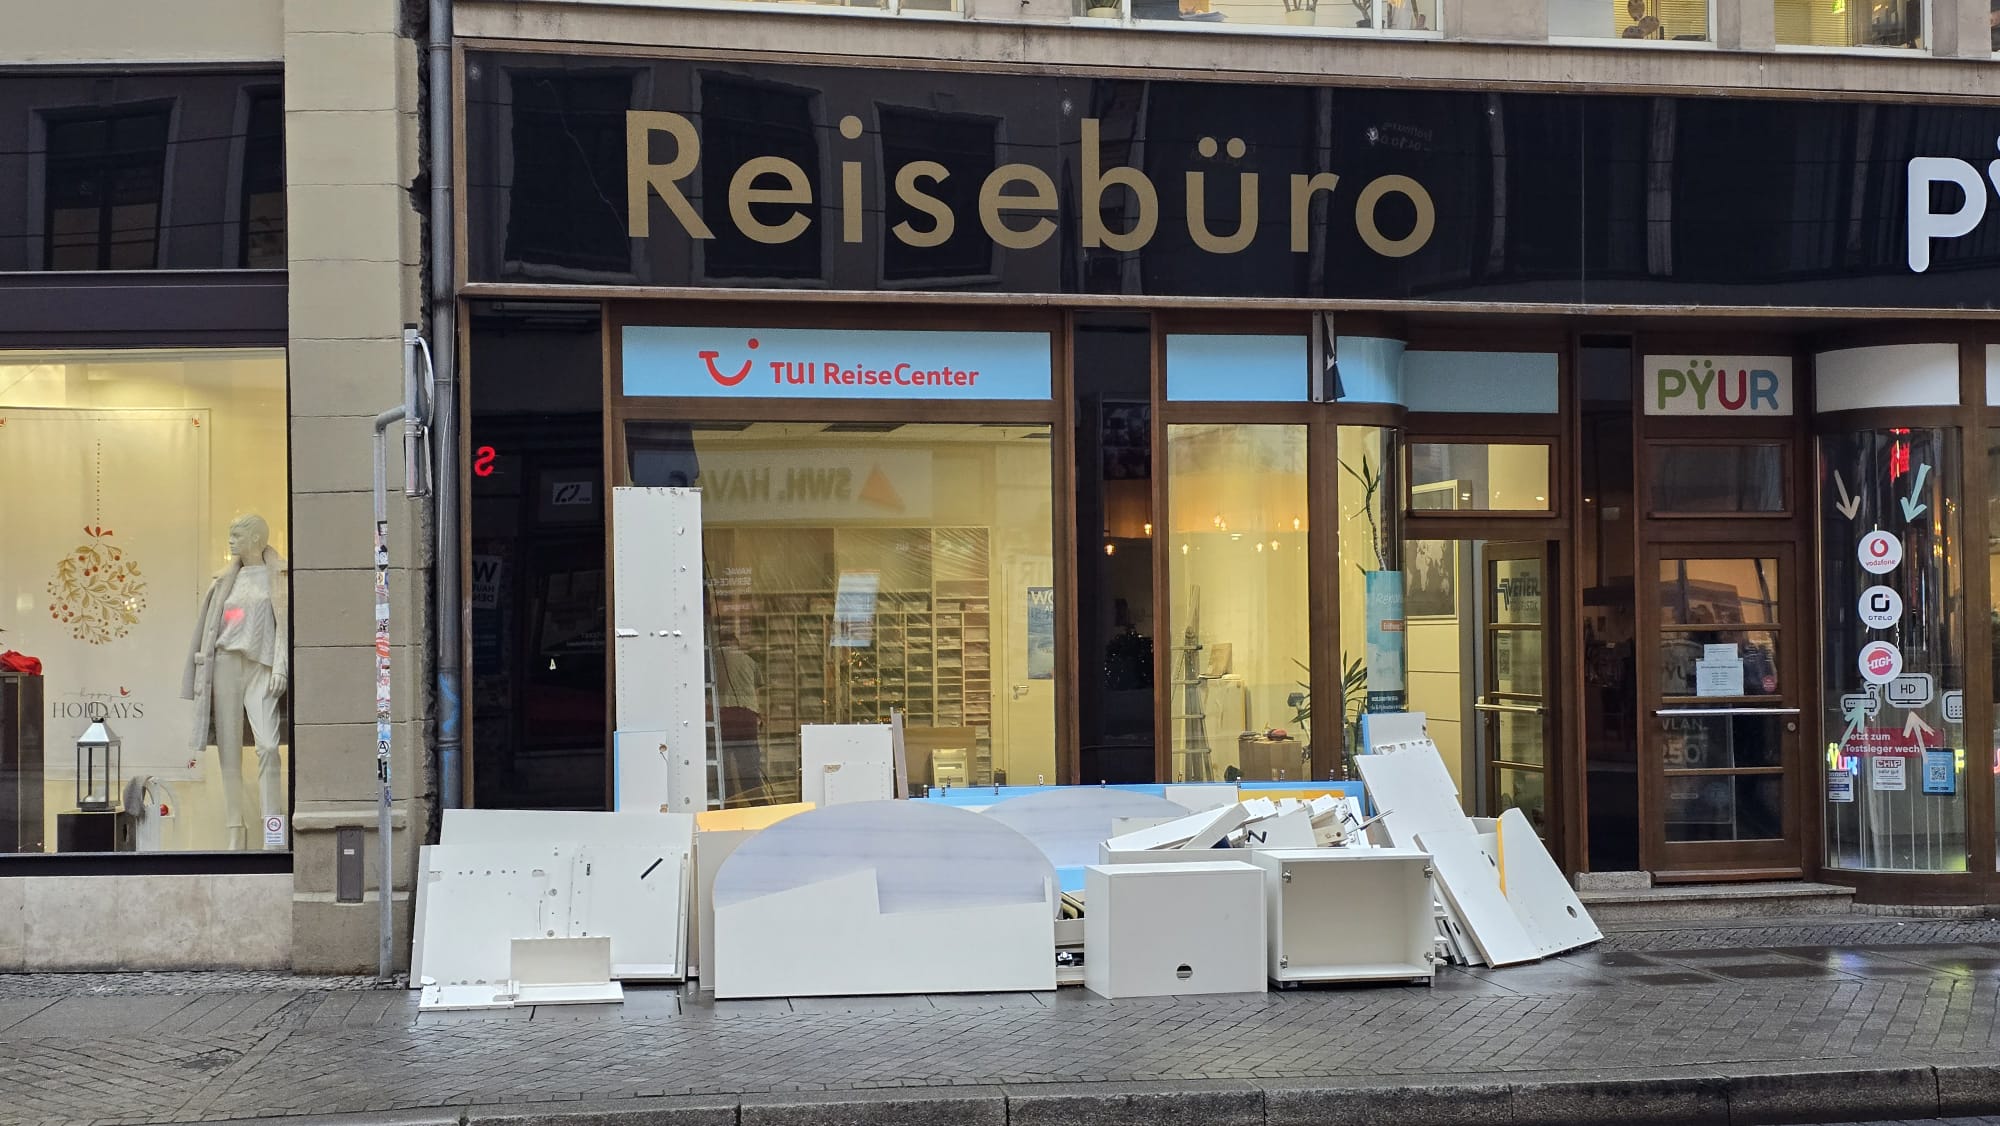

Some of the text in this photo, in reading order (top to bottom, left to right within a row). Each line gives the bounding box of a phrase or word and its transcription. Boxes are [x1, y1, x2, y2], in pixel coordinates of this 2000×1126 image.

[626, 110, 1436, 258] Reisebüro
[1908, 136, 2000, 273] P
[770, 362, 980, 386] TUI ReiseCenter
[1657, 359, 1779, 411] PŸUR
[1865, 558, 1896, 567] vodafone
[1901, 683, 1916, 694] HD
